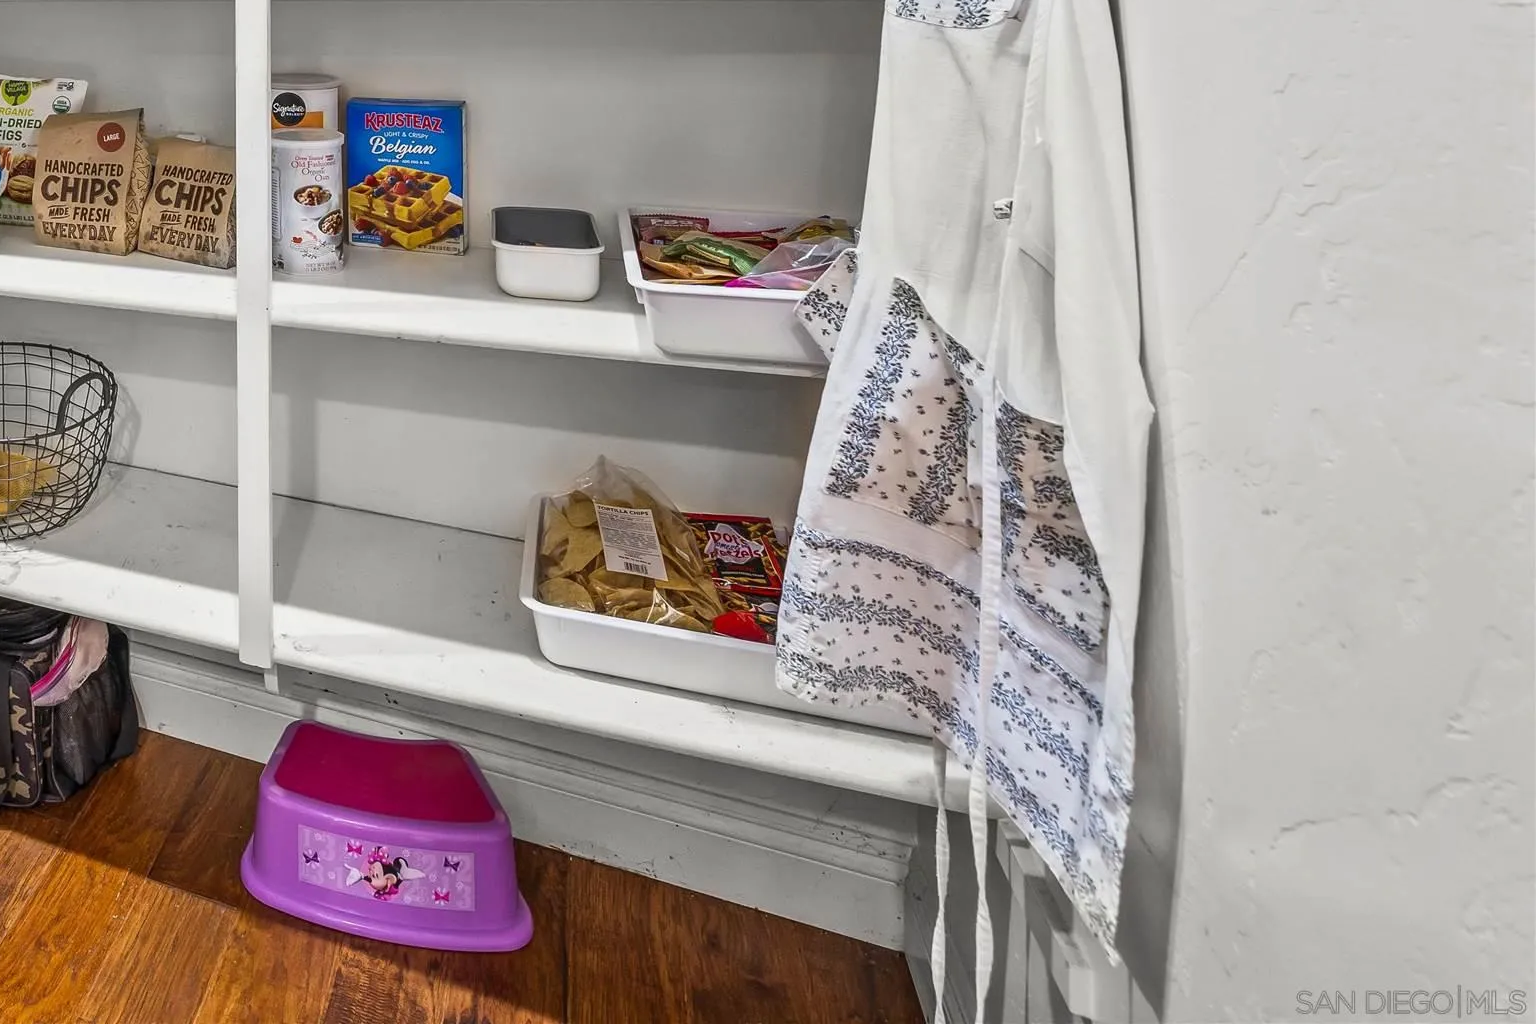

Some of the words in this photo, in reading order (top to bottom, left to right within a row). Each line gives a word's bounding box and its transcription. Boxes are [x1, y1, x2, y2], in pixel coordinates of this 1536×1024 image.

[273, 103, 305, 117] Signature
[365, 112, 443, 132] KRUSTEAZ
[103, 132, 120, 142] LARGE
[408, 132, 429, 140] CRISPY
[369, 136, 437, 159] Belgian
[44, 159, 124, 177] HANDCRAFTED
[291, 160, 306, 168] Old
[308, 160, 336, 168] Fashioned
[302, 167, 325, 176] Organic
[162, 164, 233, 186] HANDCRAFTED
[40, 175, 122, 207] CHIPS
[155, 180, 226, 217] CHIPS
[49, 207, 69, 218] MADE
[73, 206, 110, 222] FRESH
[160, 212, 181, 223] MADE
[184, 215, 216, 233] FRESH
[597, 505, 628, 515] TORTILLA
[629, 508, 649, 516] CHIPS
